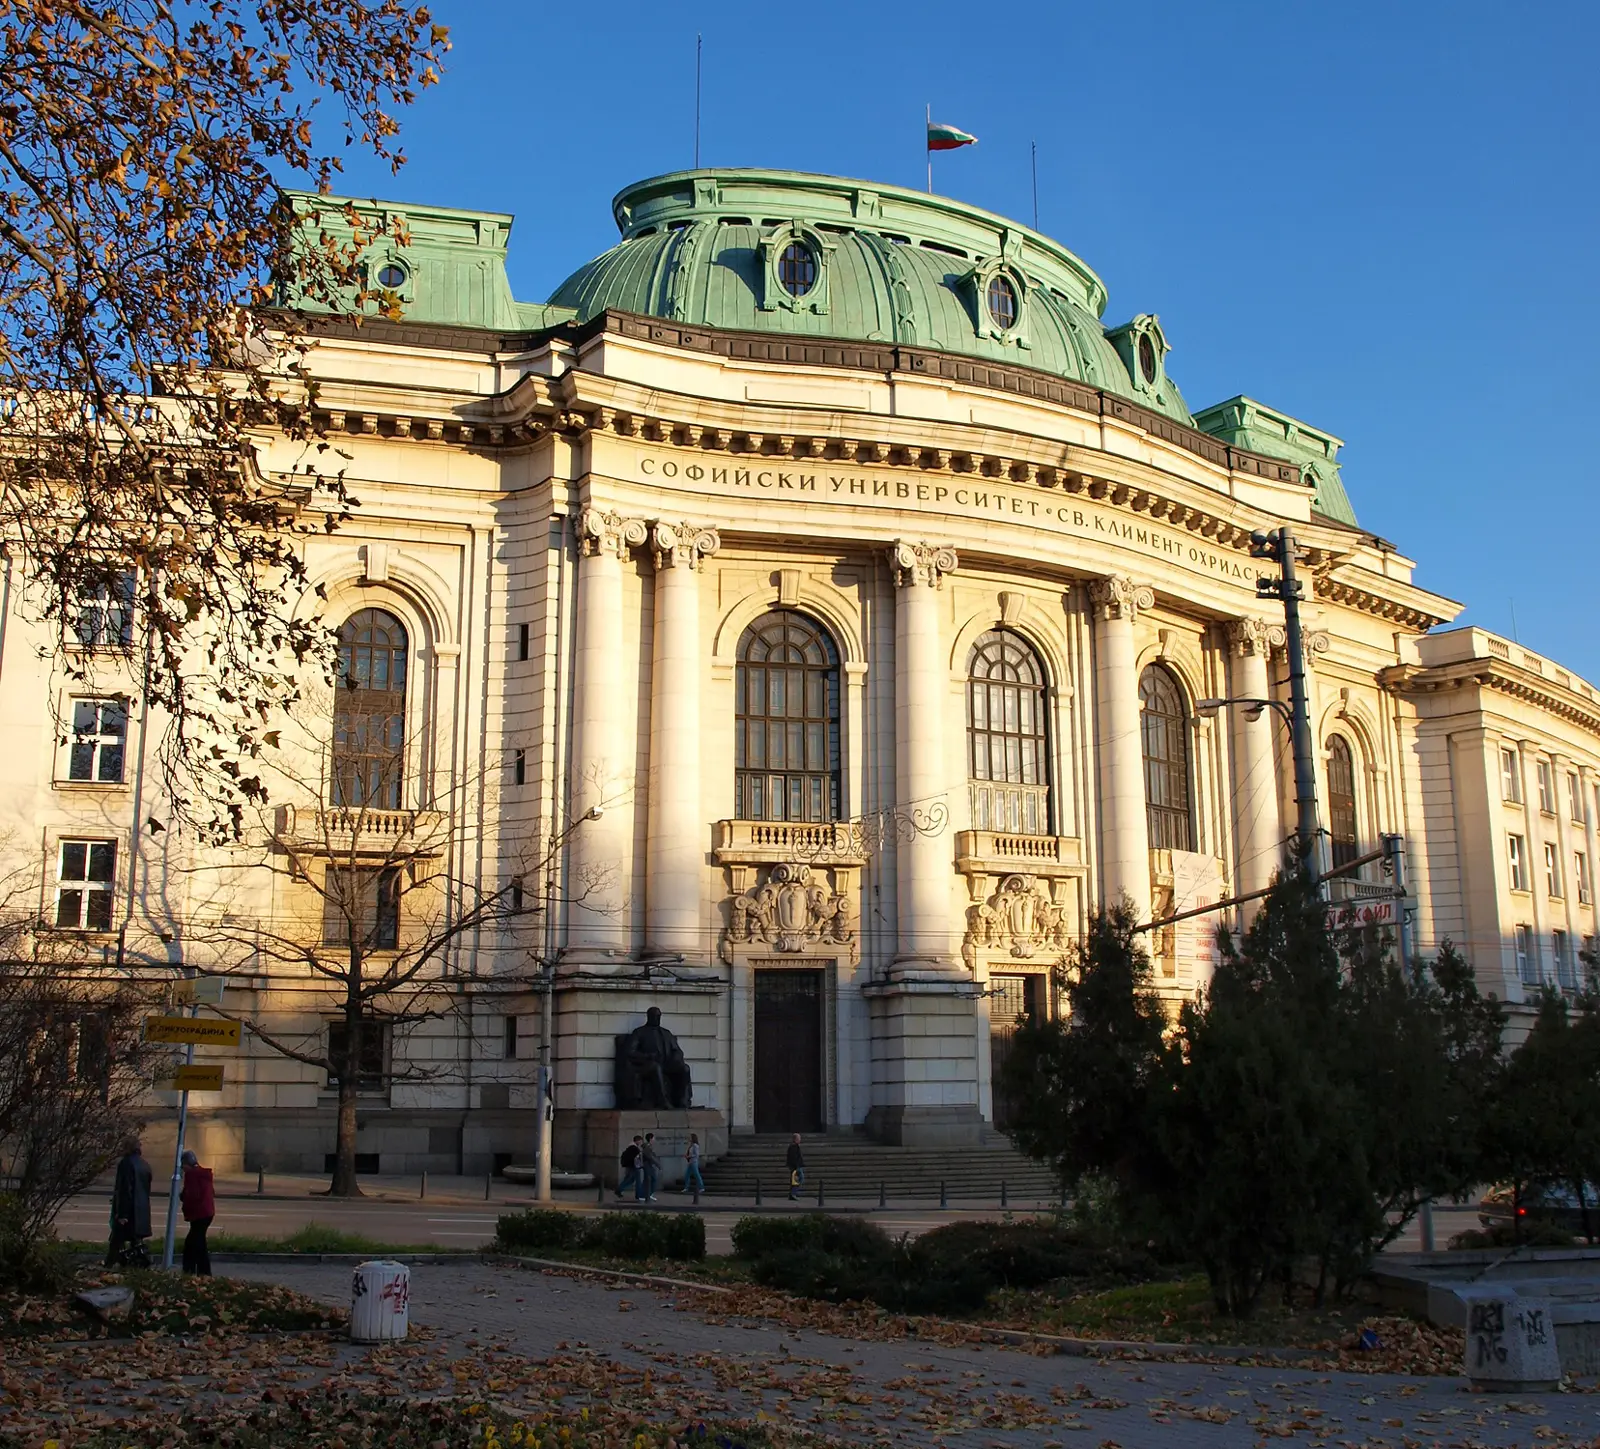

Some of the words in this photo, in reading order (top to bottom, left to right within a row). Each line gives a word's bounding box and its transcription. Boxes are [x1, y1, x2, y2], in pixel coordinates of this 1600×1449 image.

[640, 457, 817, 491] СОФИЙСКИ
[829, 475, 1040, 516] УНИВЕРСИТЕТ
[1057, 506, 1090, 528] СВ.
[1094, 514, 1184, 558] КЛИМЕНТ
